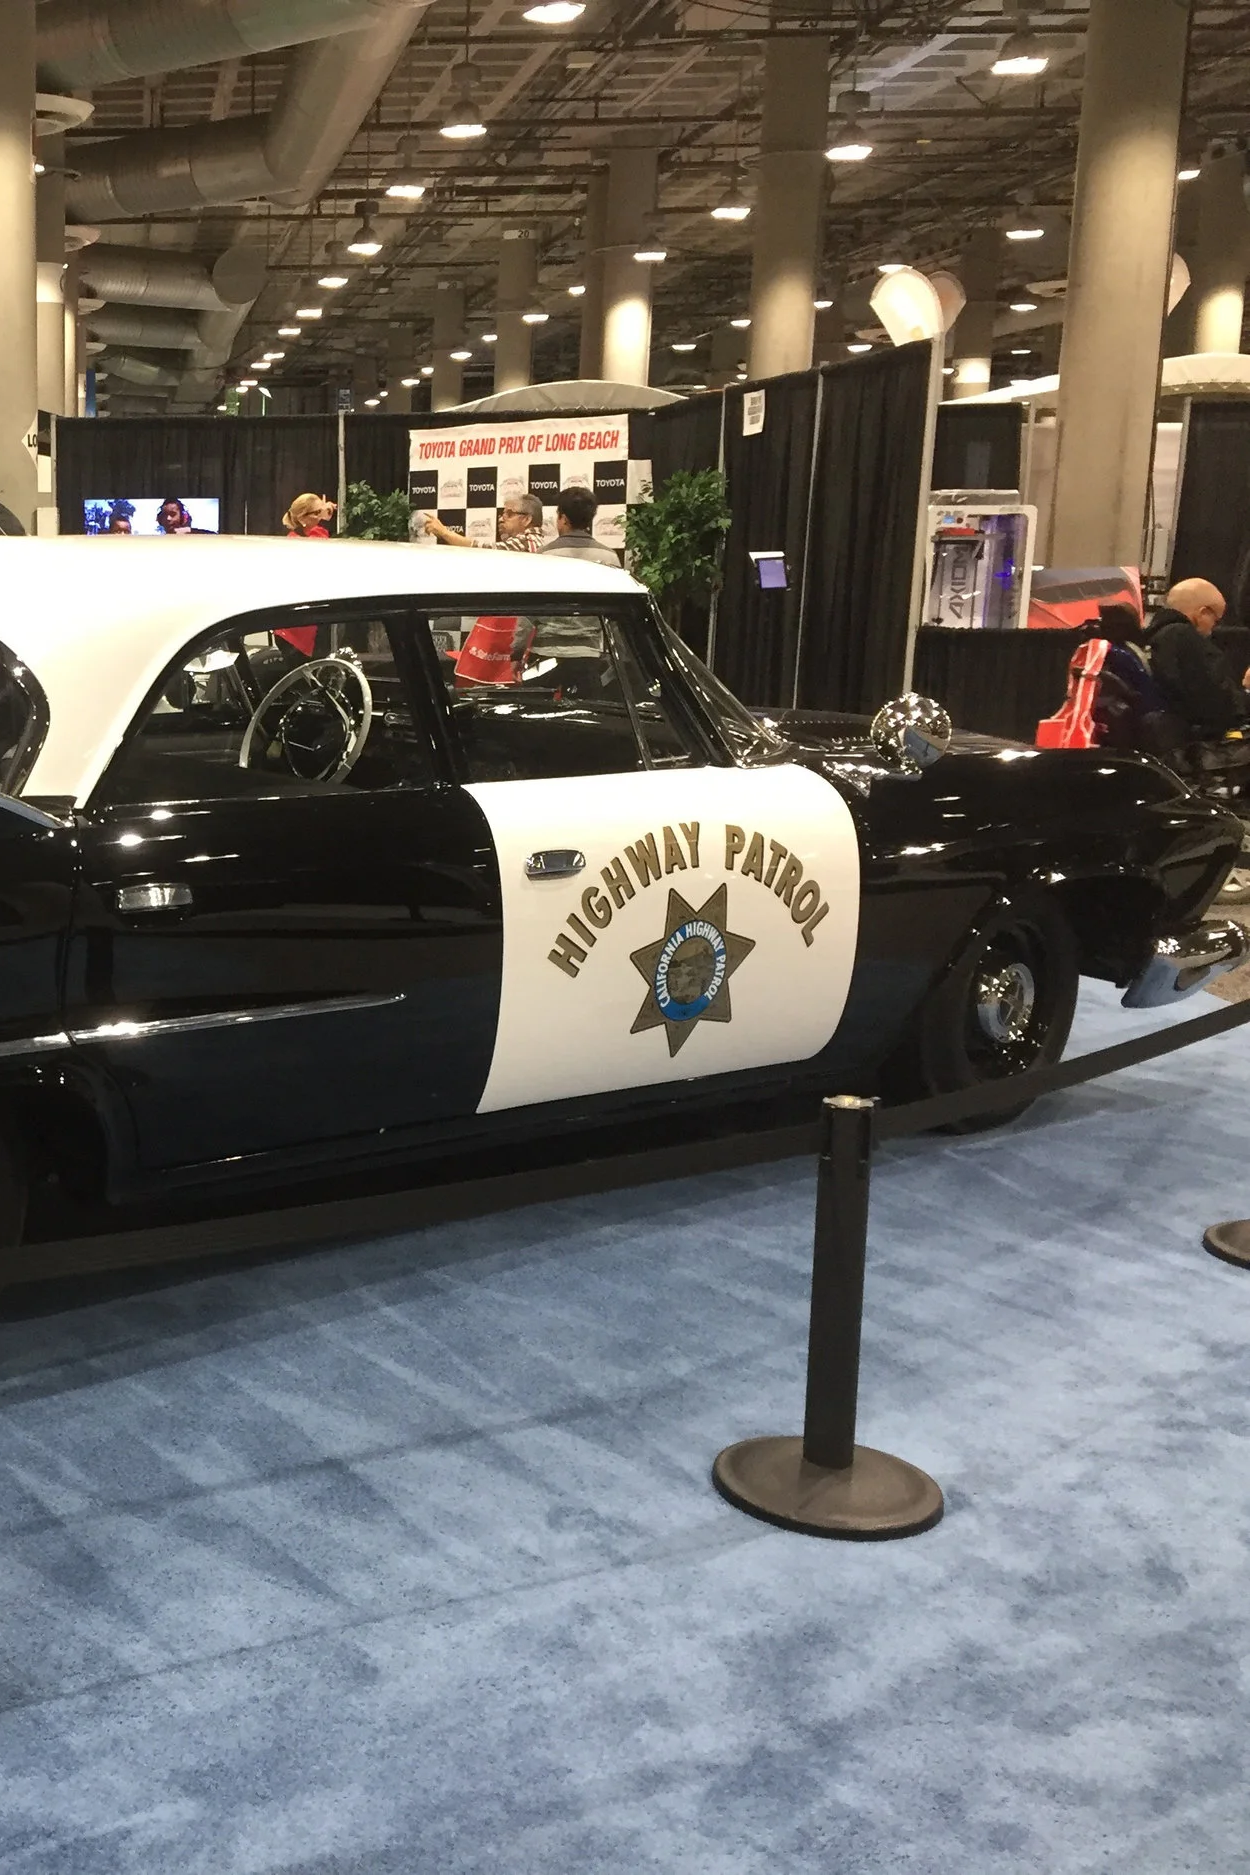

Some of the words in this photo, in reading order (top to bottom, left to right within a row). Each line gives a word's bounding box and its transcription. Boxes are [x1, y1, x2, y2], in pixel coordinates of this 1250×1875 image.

[518, 229, 530, 239] 20
[418, 441, 456, 460] TOYOTA
[459, 438, 496, 457] GRAND
[498, 436, 525, 454] PRIX
[528, 434, 543, 453] OF
[545, 433, 576, 452] LONG
[579, 430, 619, 451] BEACH
[412, 486, 436, 494] TOYOTA
[469, 483, 495, 492] TOYOTA
[530, 481, 558, 489] TOYOTA
[596, 479, 625, 487] TOYOTA
[949, 546, 969, 619] AXIOM
[547, 821, 700, 978] HIGHWAY
[725, 823, 830, 947] PATROL
[685, 920, 725, 952] HIGHWAY
[656, 931, 685, 1008] CALIFORNIA
[704, 953, 726, 1001] PATROL
